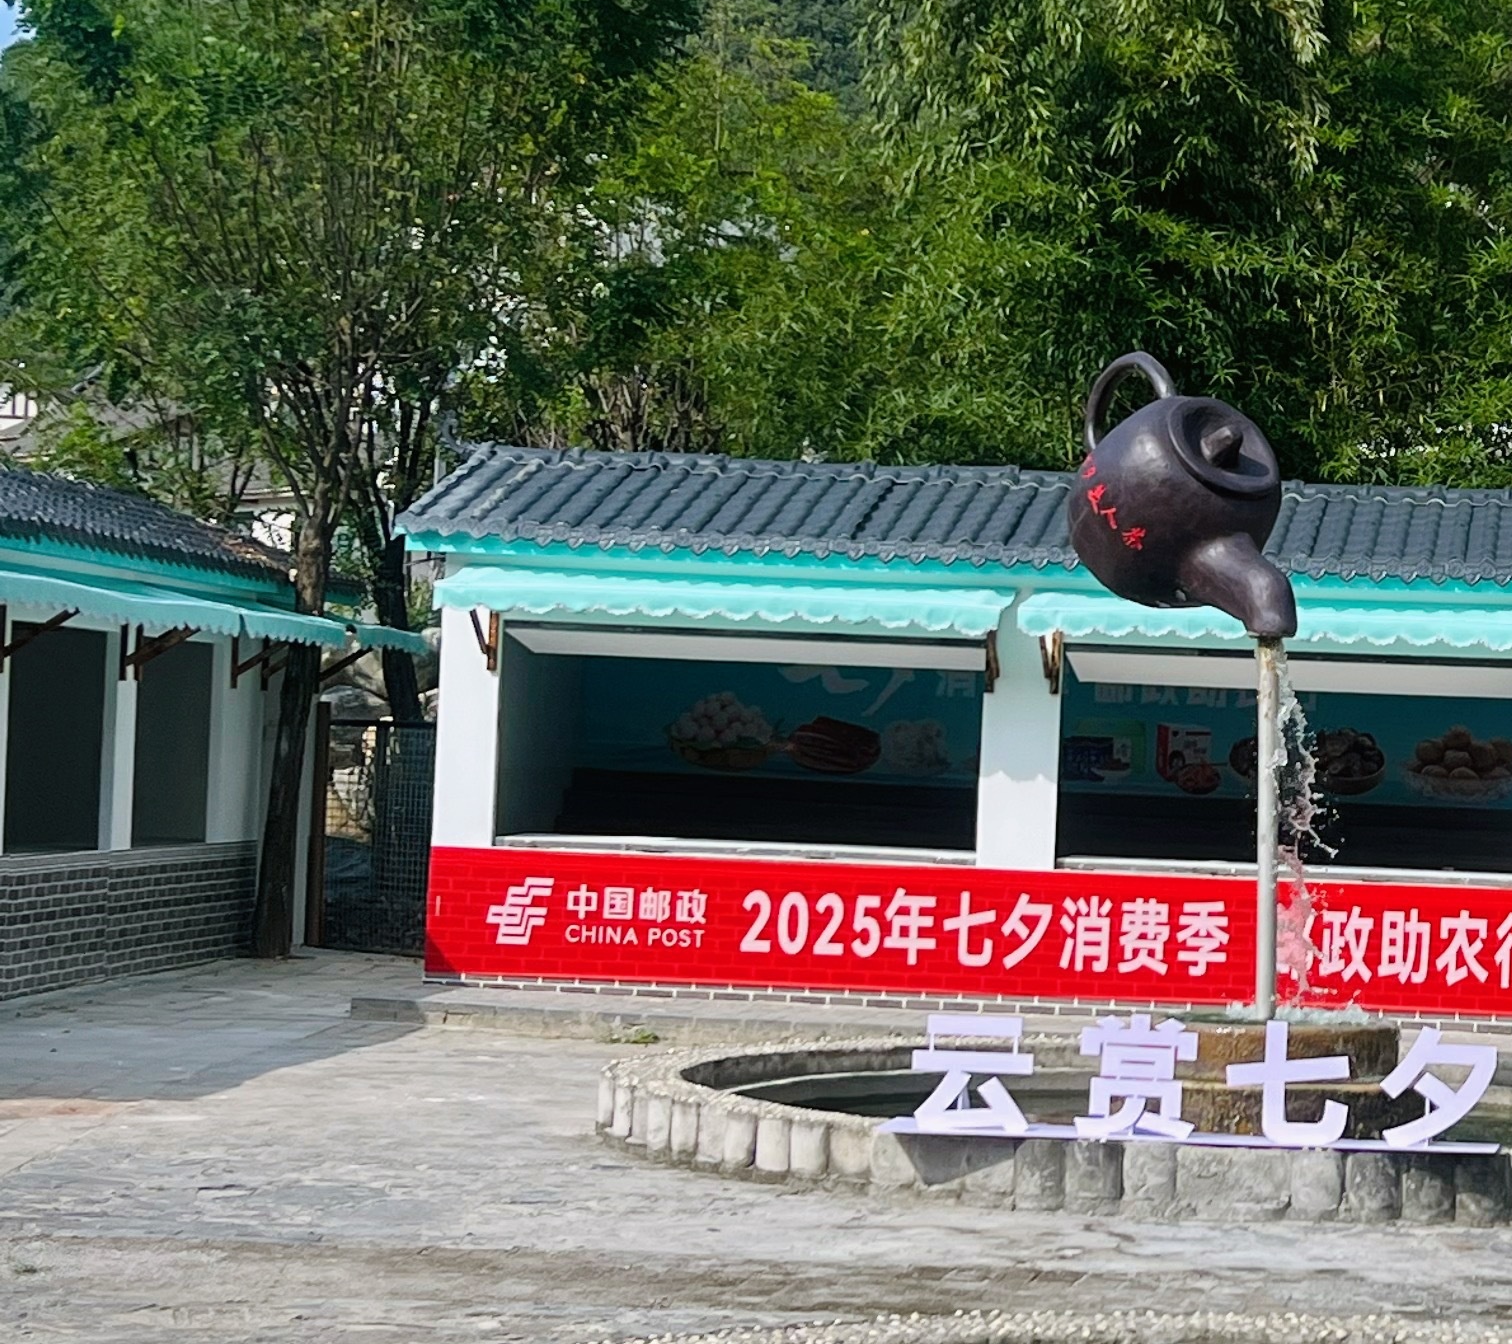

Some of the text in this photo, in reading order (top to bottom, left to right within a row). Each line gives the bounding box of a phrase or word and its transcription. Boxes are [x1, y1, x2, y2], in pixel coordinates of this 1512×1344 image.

[565, 924, 706, 948] CHINA POST
[566, 883, 708, 925] 中国邮政
[739, 887, 1230, 976] 2025年七夕消费季
[911, 1012, 1499, 1148] 云赏七夕
